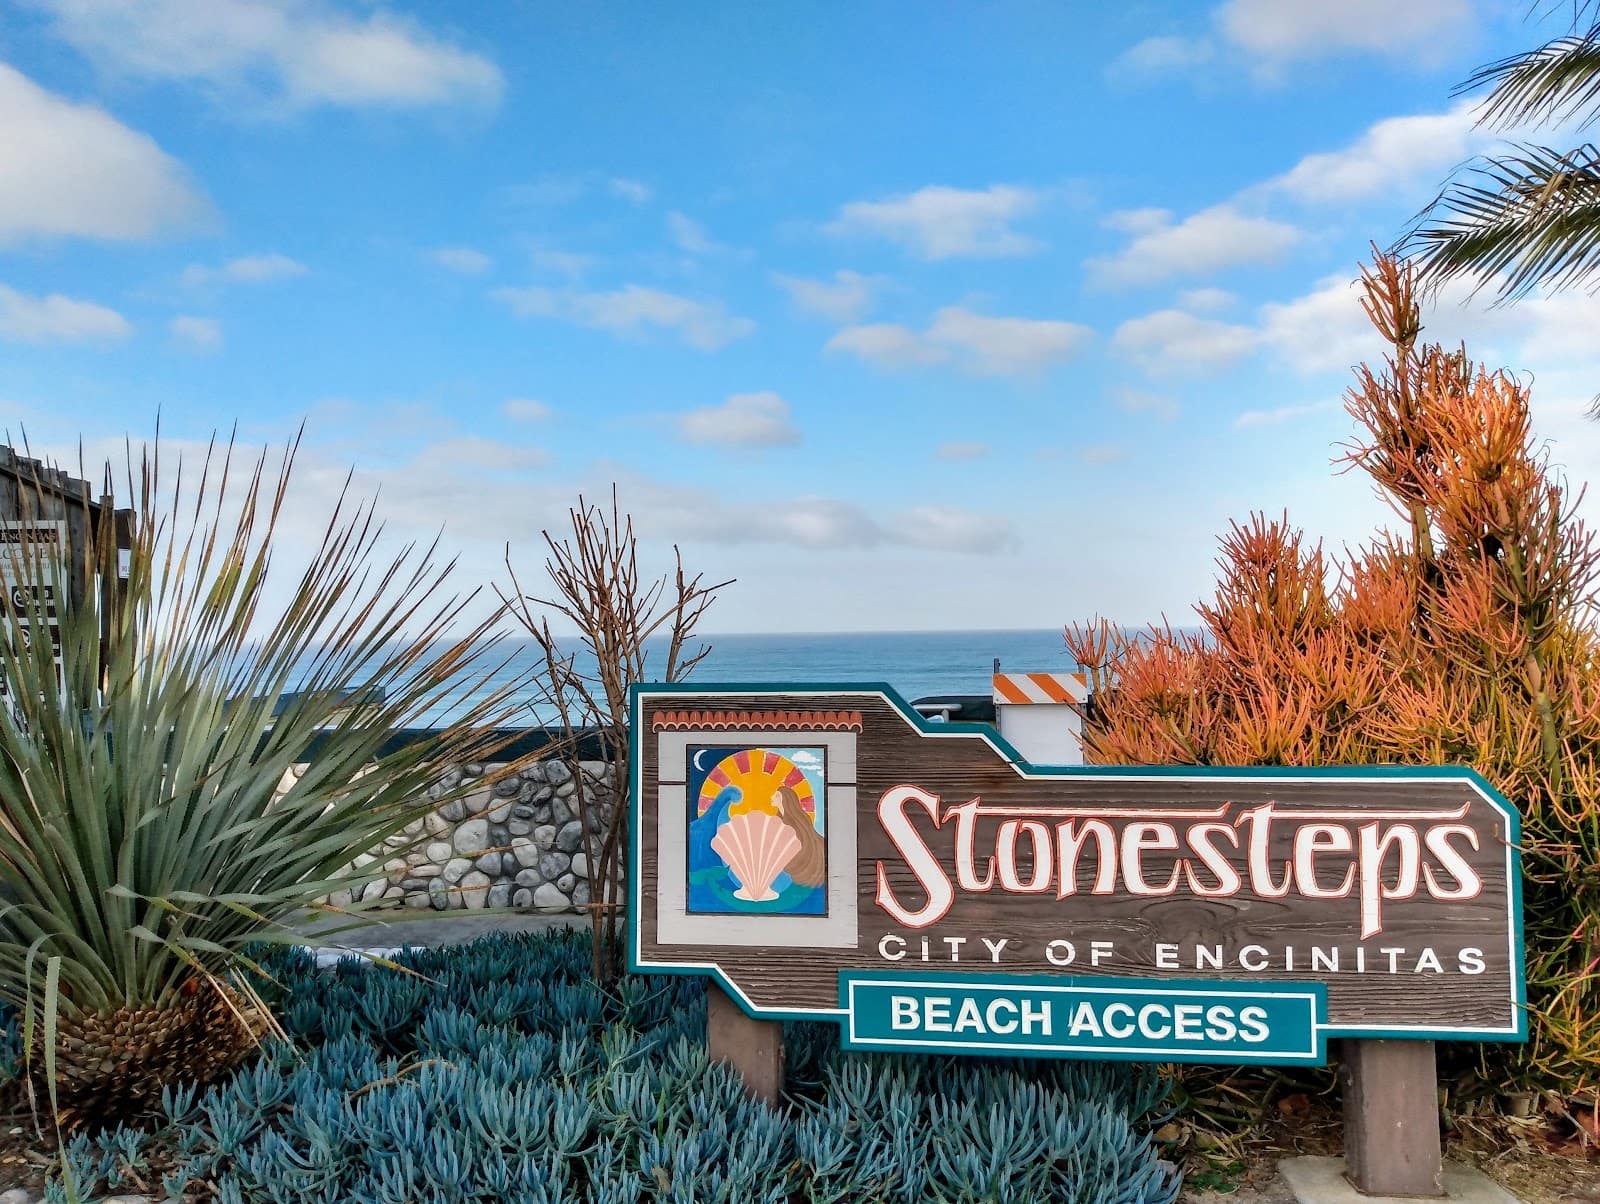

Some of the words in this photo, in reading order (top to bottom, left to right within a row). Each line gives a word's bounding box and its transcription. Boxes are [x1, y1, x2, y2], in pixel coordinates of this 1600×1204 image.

[876, 785, 1482, 940] Stonesteps
[879, 934, 1009, 963] CITY
[1045, 939, 1113, 967] OF
[1155, 943, 1487, 974] ENCINITAS
[891, 996, 1053, 1036] BEACH
[1069, 1002, 1270, 1043] ACCESS
